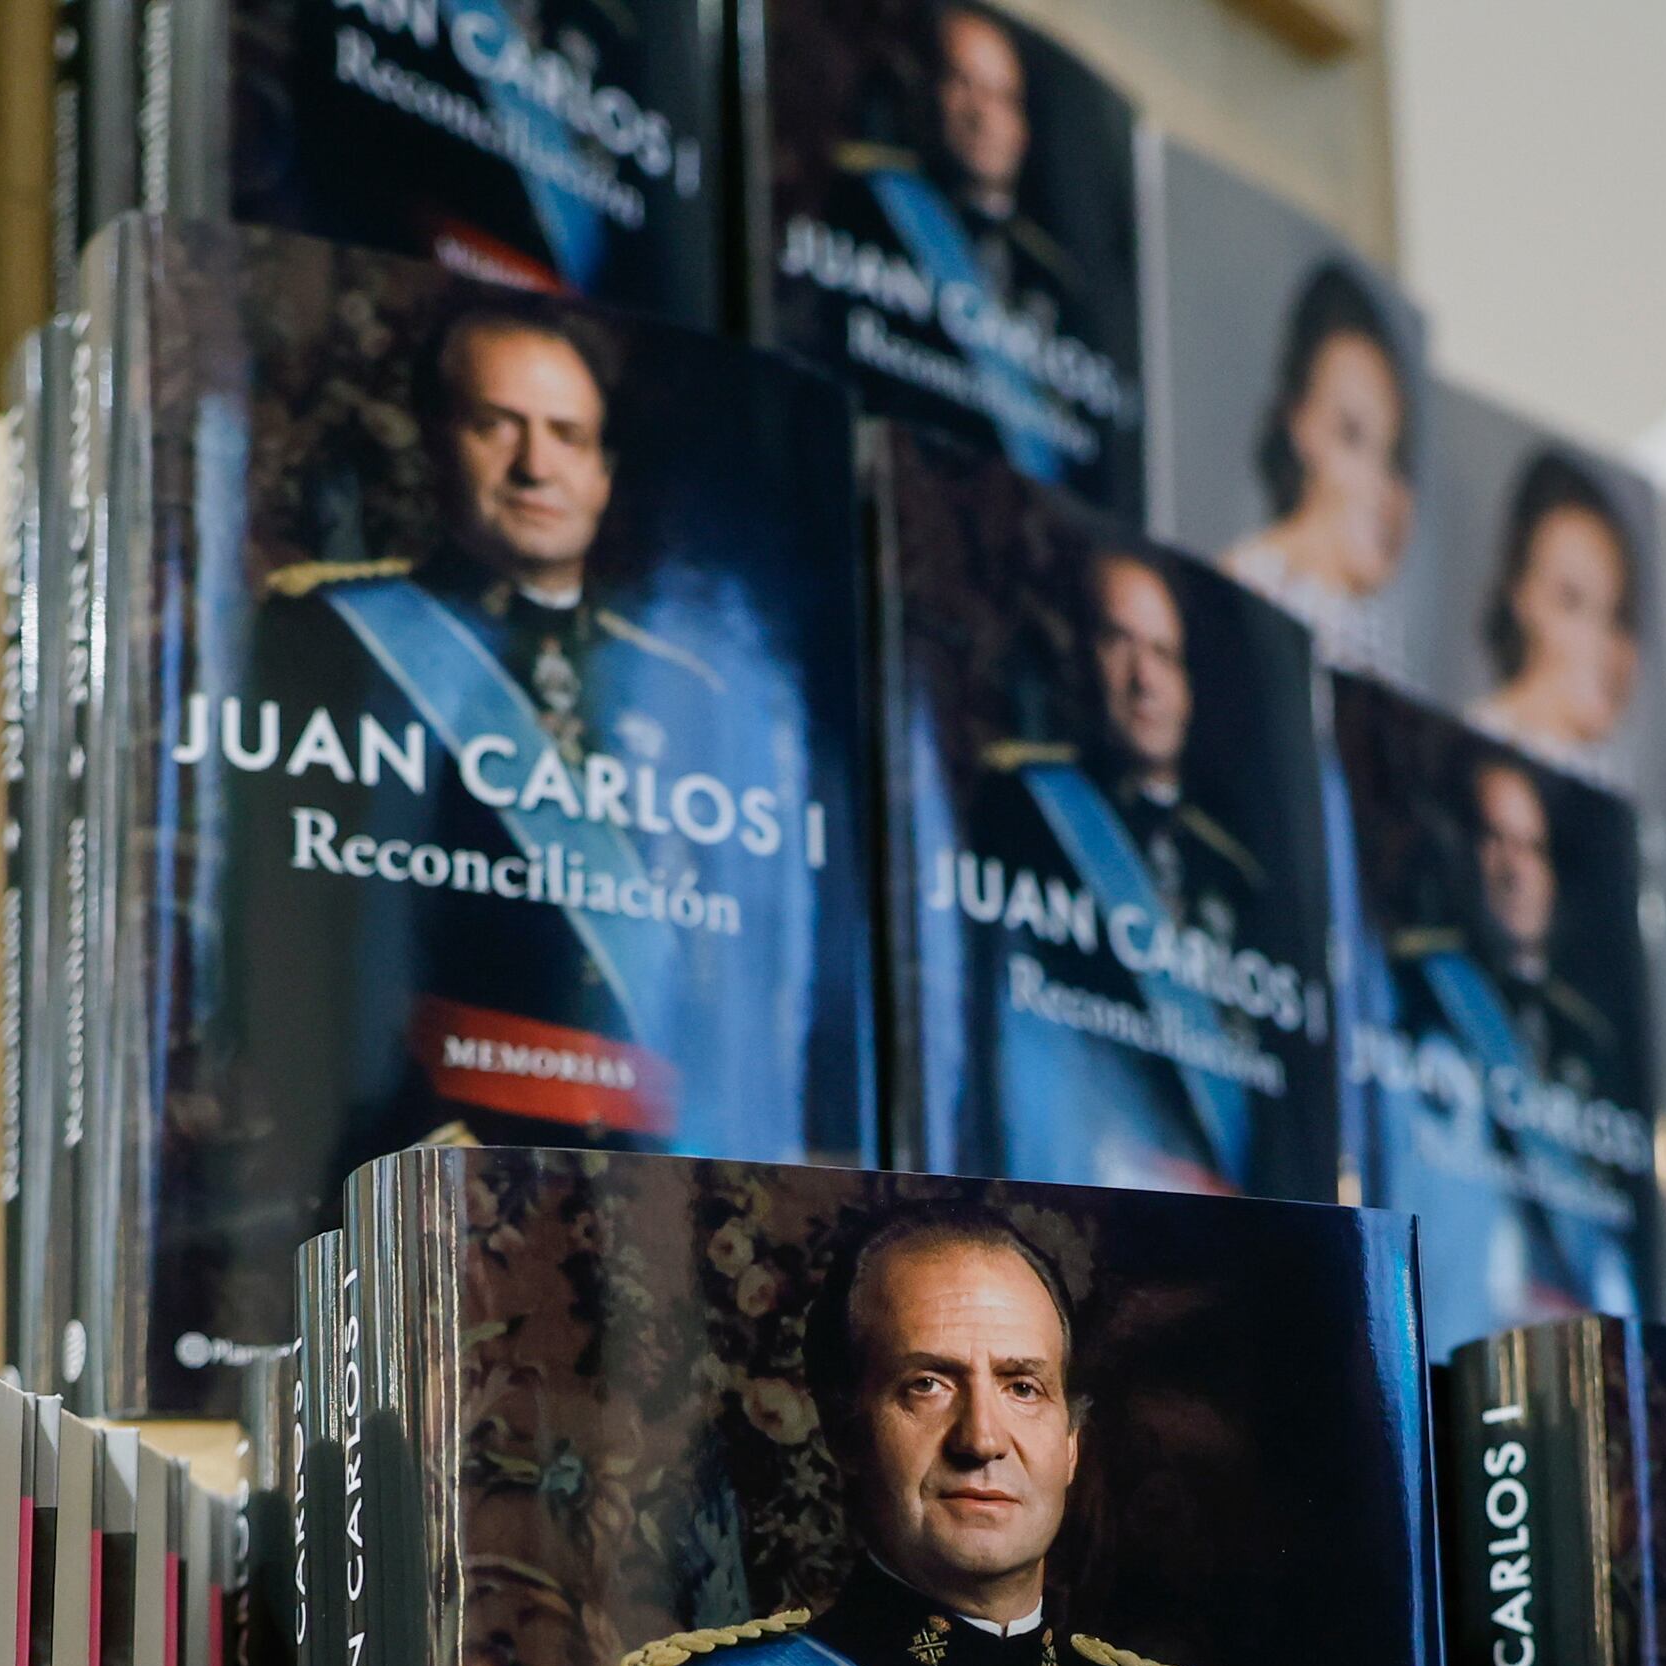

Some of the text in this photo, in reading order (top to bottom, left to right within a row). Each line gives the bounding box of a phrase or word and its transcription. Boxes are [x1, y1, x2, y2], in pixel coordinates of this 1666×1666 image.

[171, 692, 827, 869] JUAN CARLOS I
[293, 805, 743, 934] Reconciliación
[933, 849, 1096, 953] JUAN
[1106, 902, 1303, 1032] CARLOS
[343, 1267, 359, 1287] I
[343, 1330, 365, 1602] CARLOS
[1482, 1403, 1525, 1427] I
